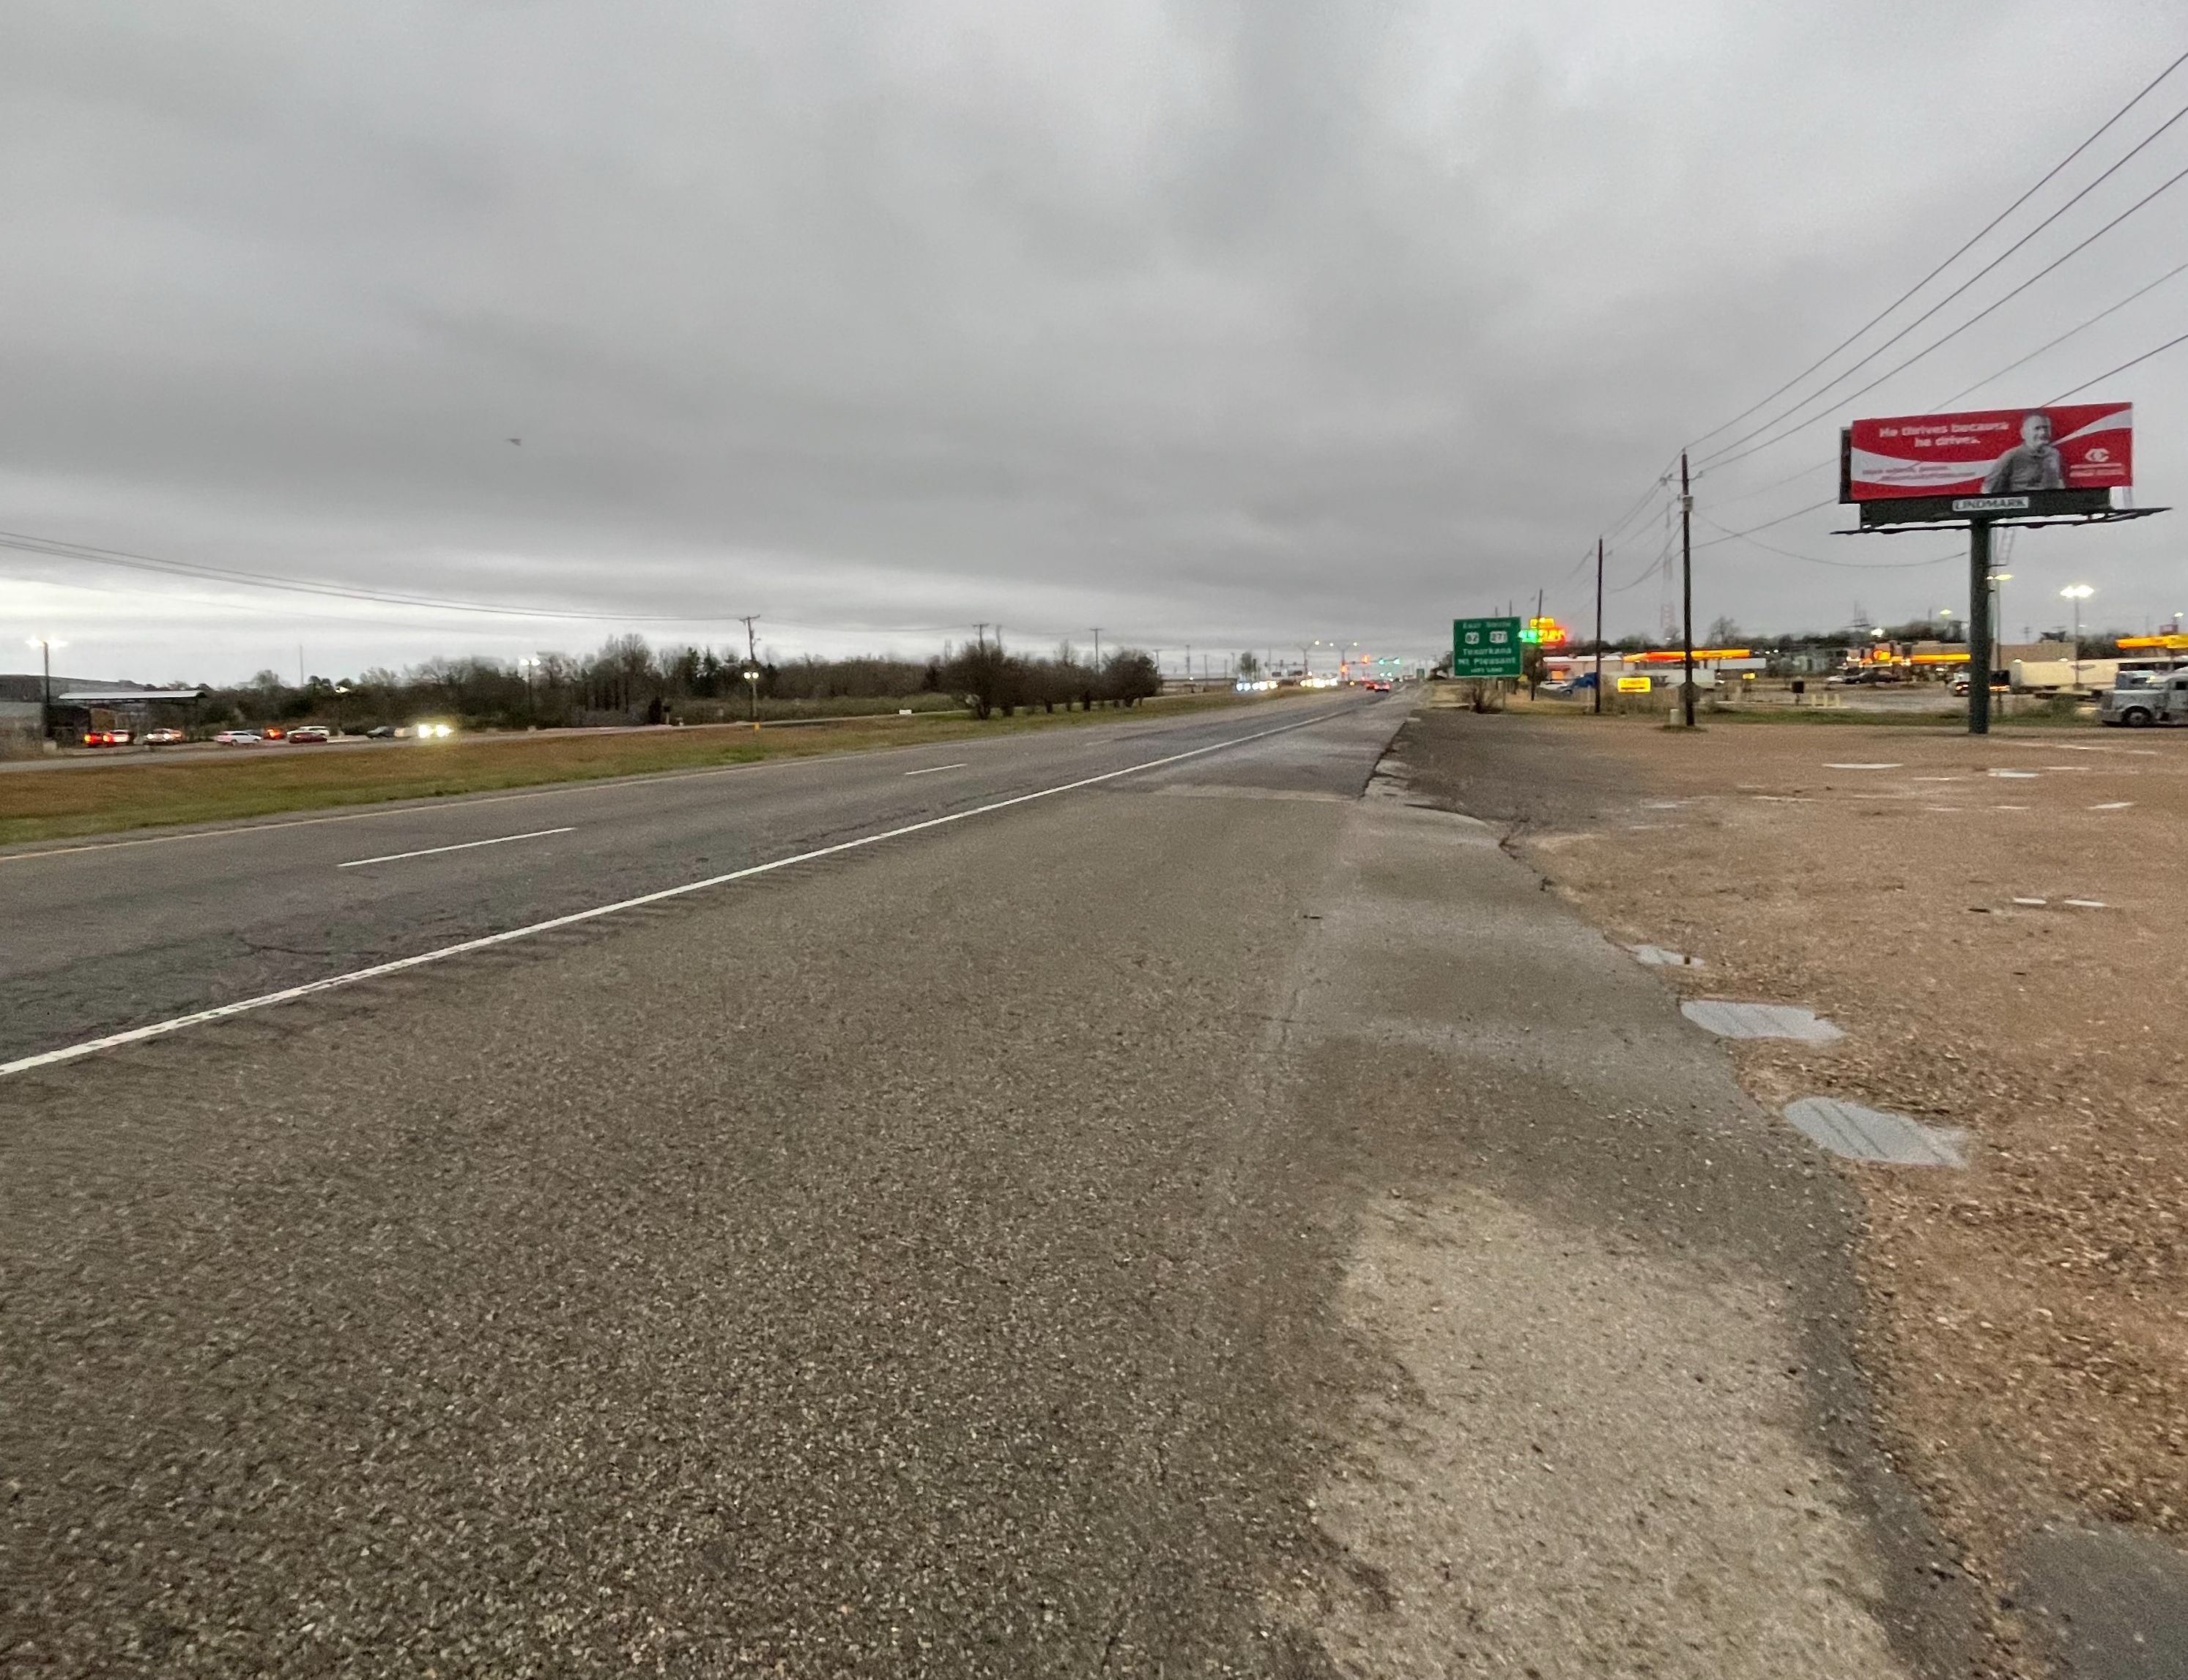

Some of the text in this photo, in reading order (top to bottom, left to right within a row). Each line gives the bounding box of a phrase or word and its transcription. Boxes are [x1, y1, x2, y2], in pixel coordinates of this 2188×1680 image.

[1879, 427, 1898, 438] He
[1902, 424, 1948, 436] thrives
[1914, 437, 1932, 447] he
[1954, 499, 2027, 510] LINDMARK
[1463, 647, 1512, 655] Texarkana
[1474, 657, 1516, 668] Pleasant
